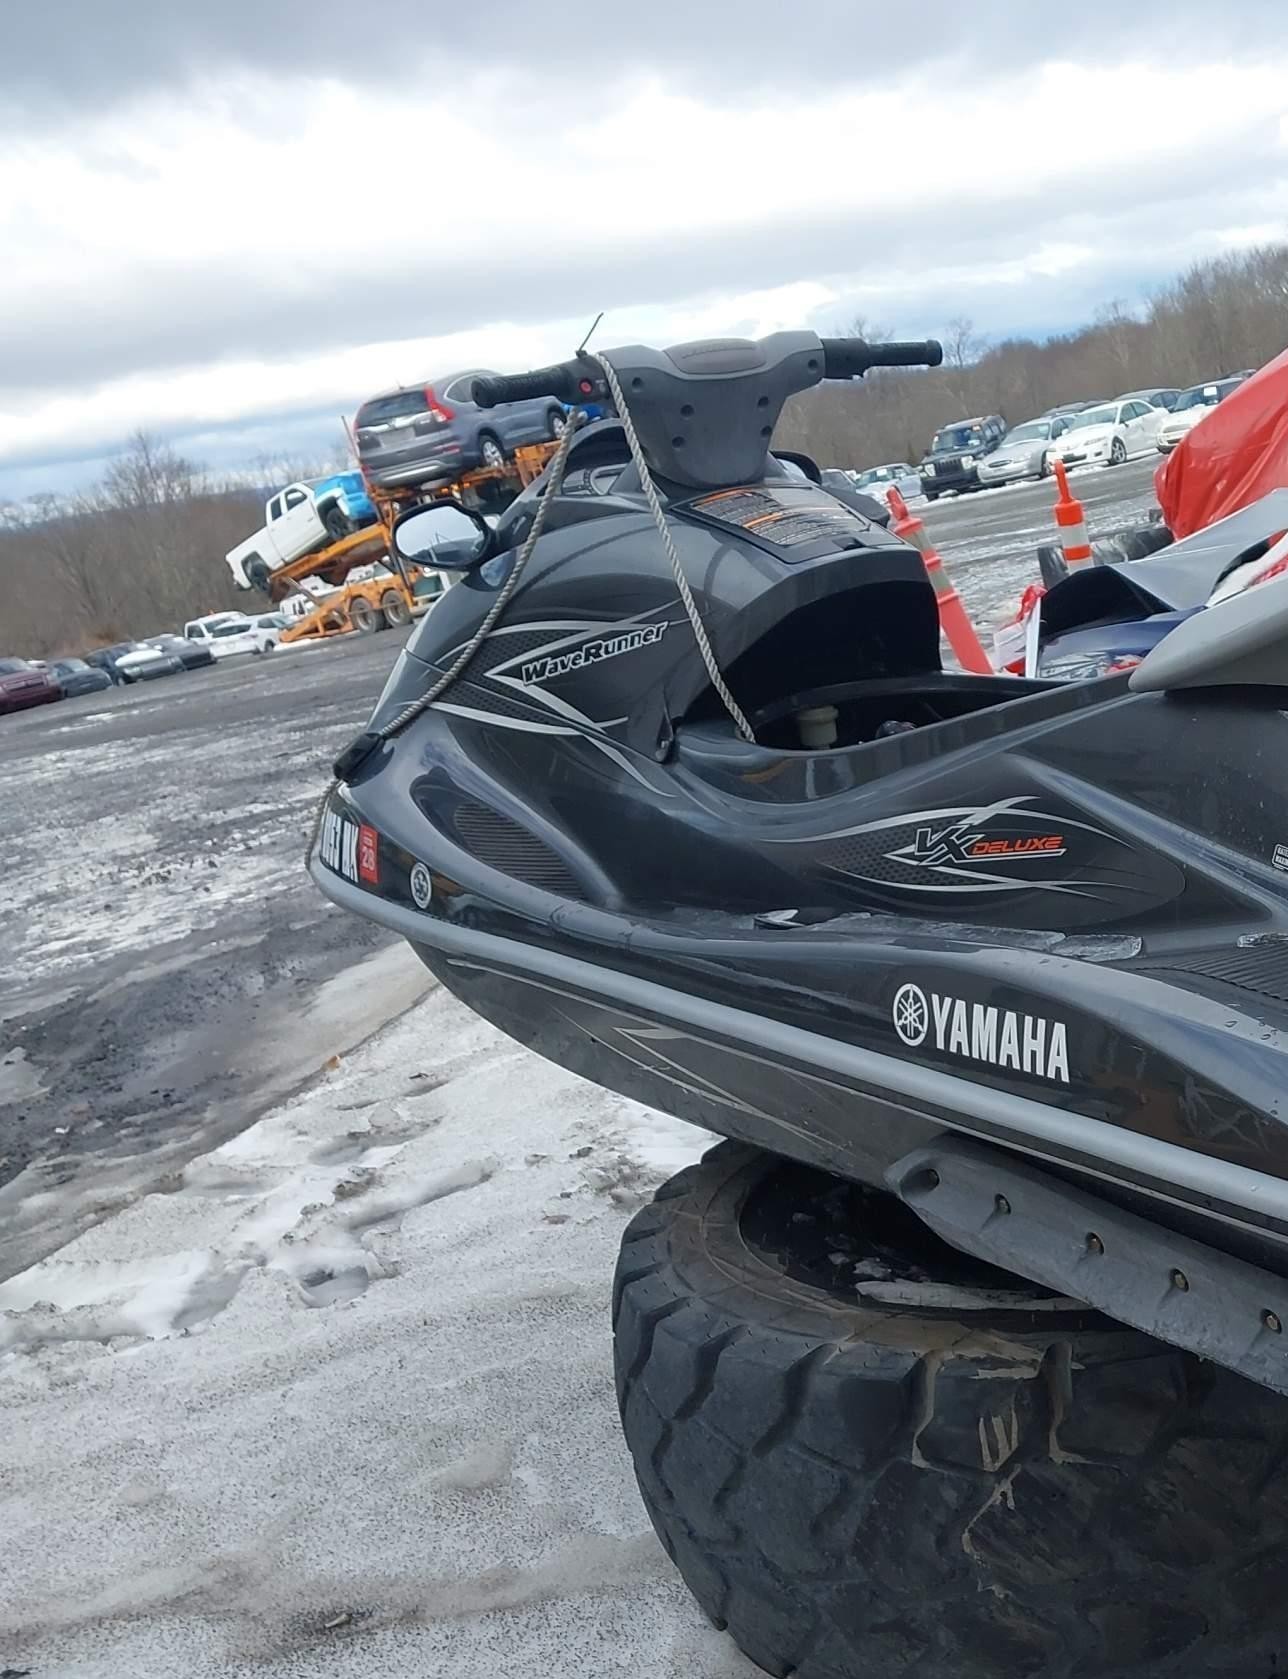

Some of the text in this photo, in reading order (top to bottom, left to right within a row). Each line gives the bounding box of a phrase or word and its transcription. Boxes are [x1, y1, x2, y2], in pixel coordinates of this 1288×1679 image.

[520, 620, 669, 686] WaveRunner
[913, 822, 1064, 867] VX DELUXE
[930, 993, 1070, 1083] YAMAHA
